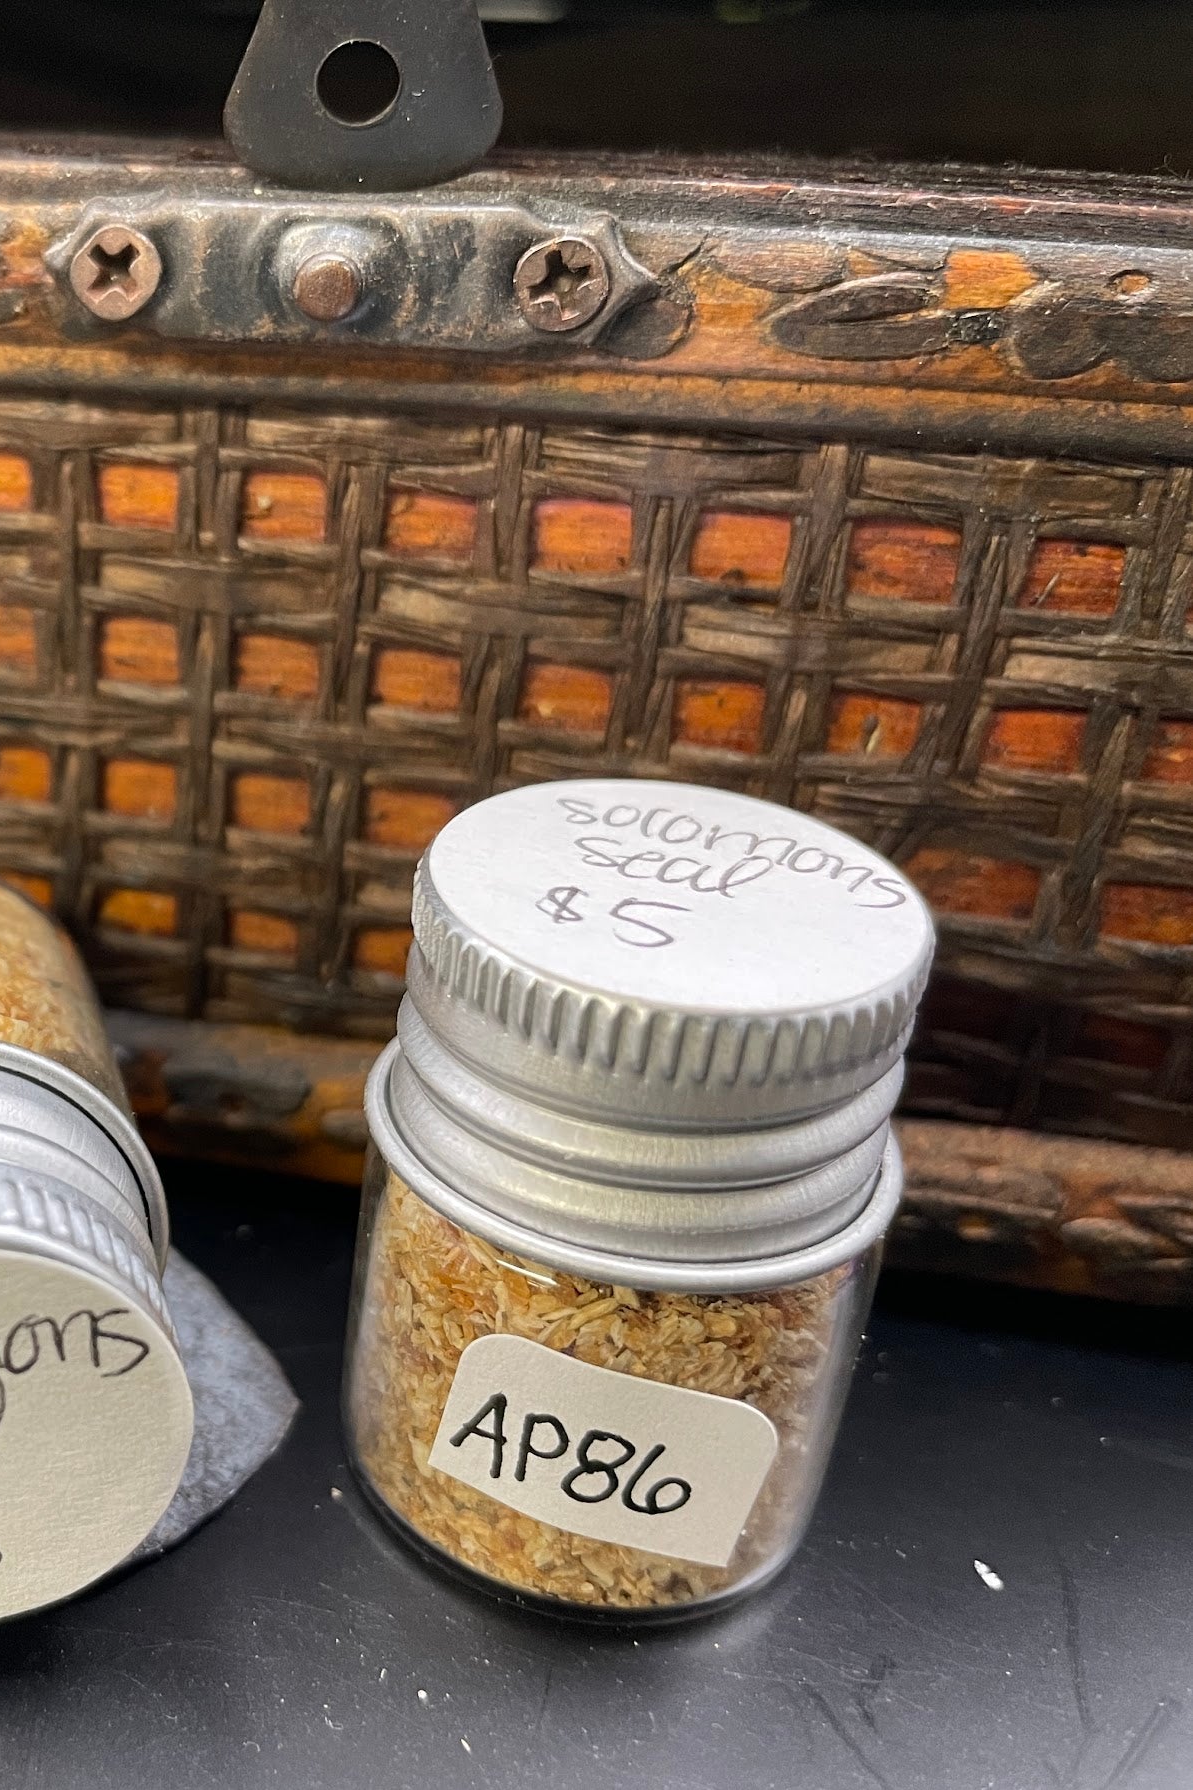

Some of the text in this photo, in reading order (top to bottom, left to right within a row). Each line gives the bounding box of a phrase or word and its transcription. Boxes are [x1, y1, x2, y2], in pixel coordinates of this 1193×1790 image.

[557, 798, 907, 909] solomons
[573, 836, 775, 899] seal
[535, 885, 693, 948] $5
[449, 1391, 692, 1515] AP86
